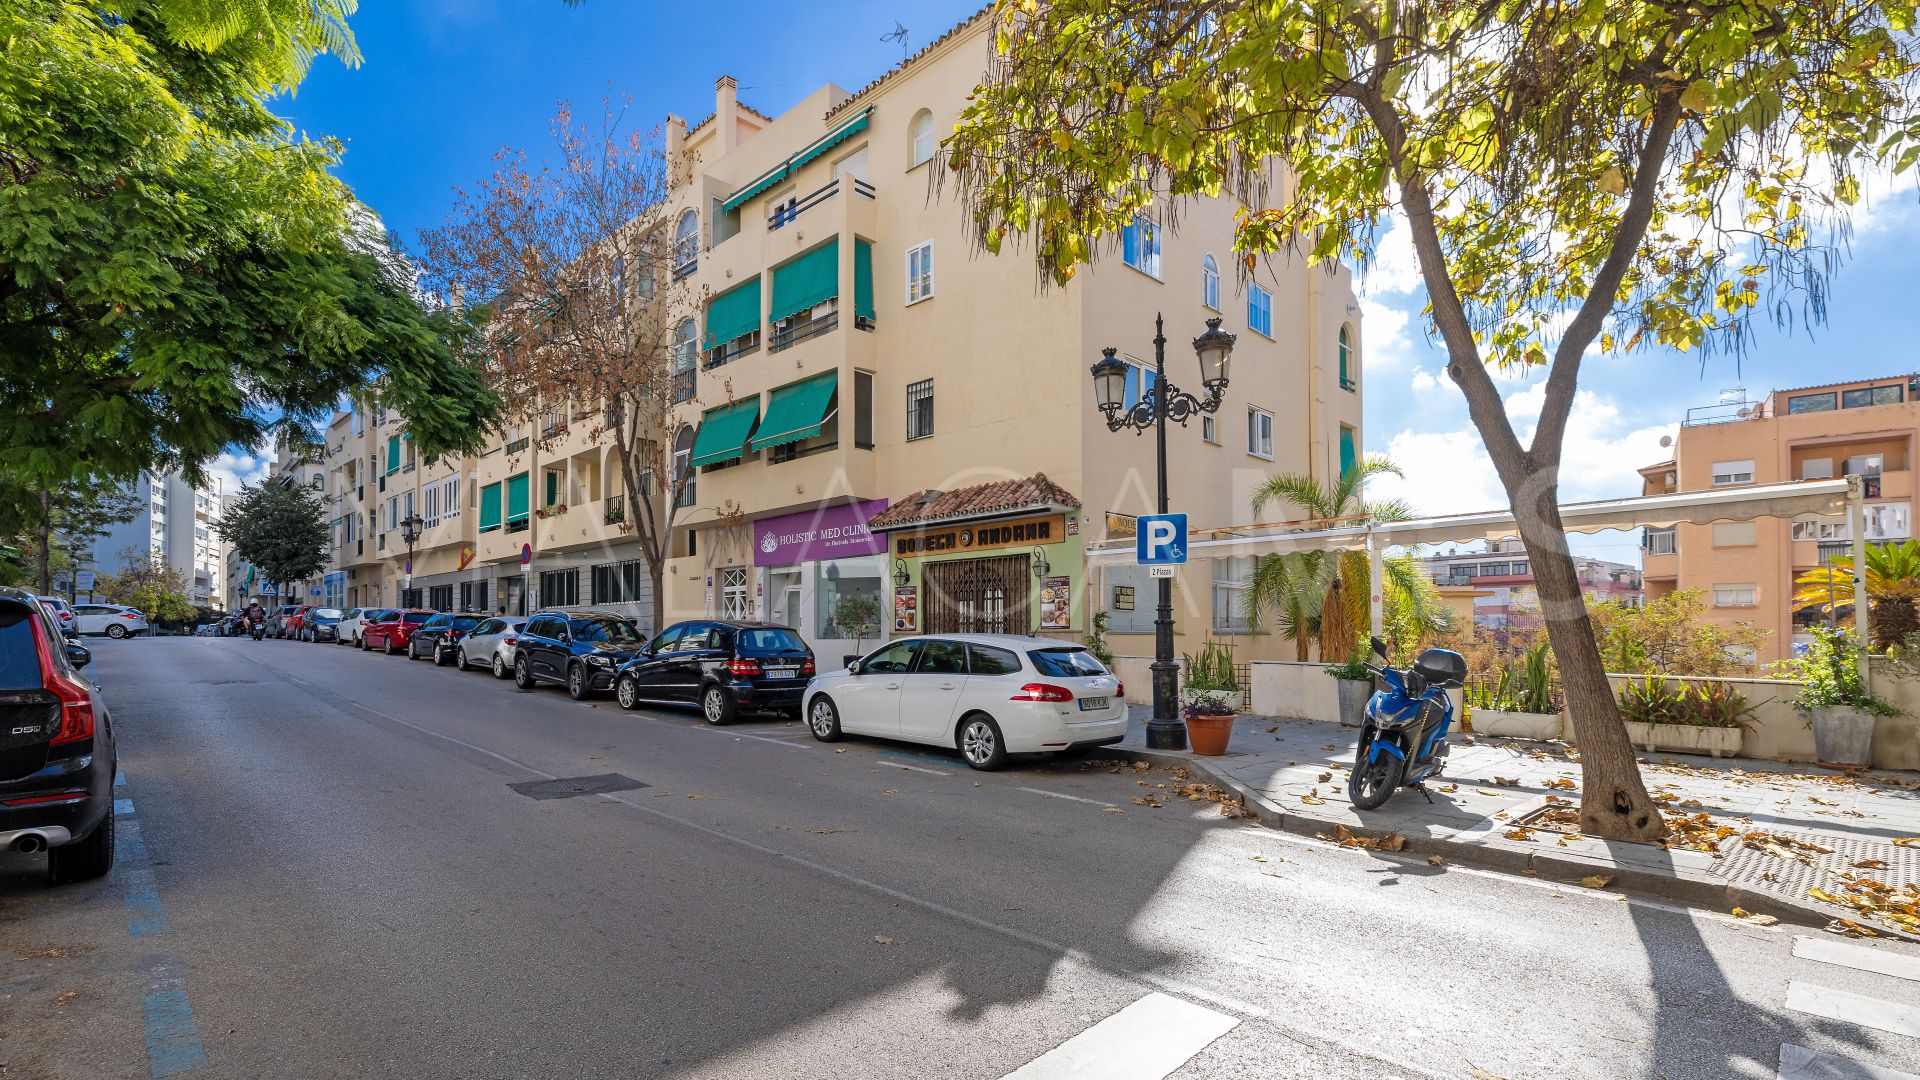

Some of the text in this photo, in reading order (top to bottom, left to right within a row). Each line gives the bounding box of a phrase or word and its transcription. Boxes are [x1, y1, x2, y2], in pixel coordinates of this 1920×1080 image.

[780, 531, 817, 545] HOLISTIC
[820, 527, 841, 540] MED
[897, 533, 955, 554] BODEGA
[977, 522, 1050, 546] ANDANA
[1147, 520, 1177, 559] P
[1152, 567, 1172, 576] 2 Plazas
